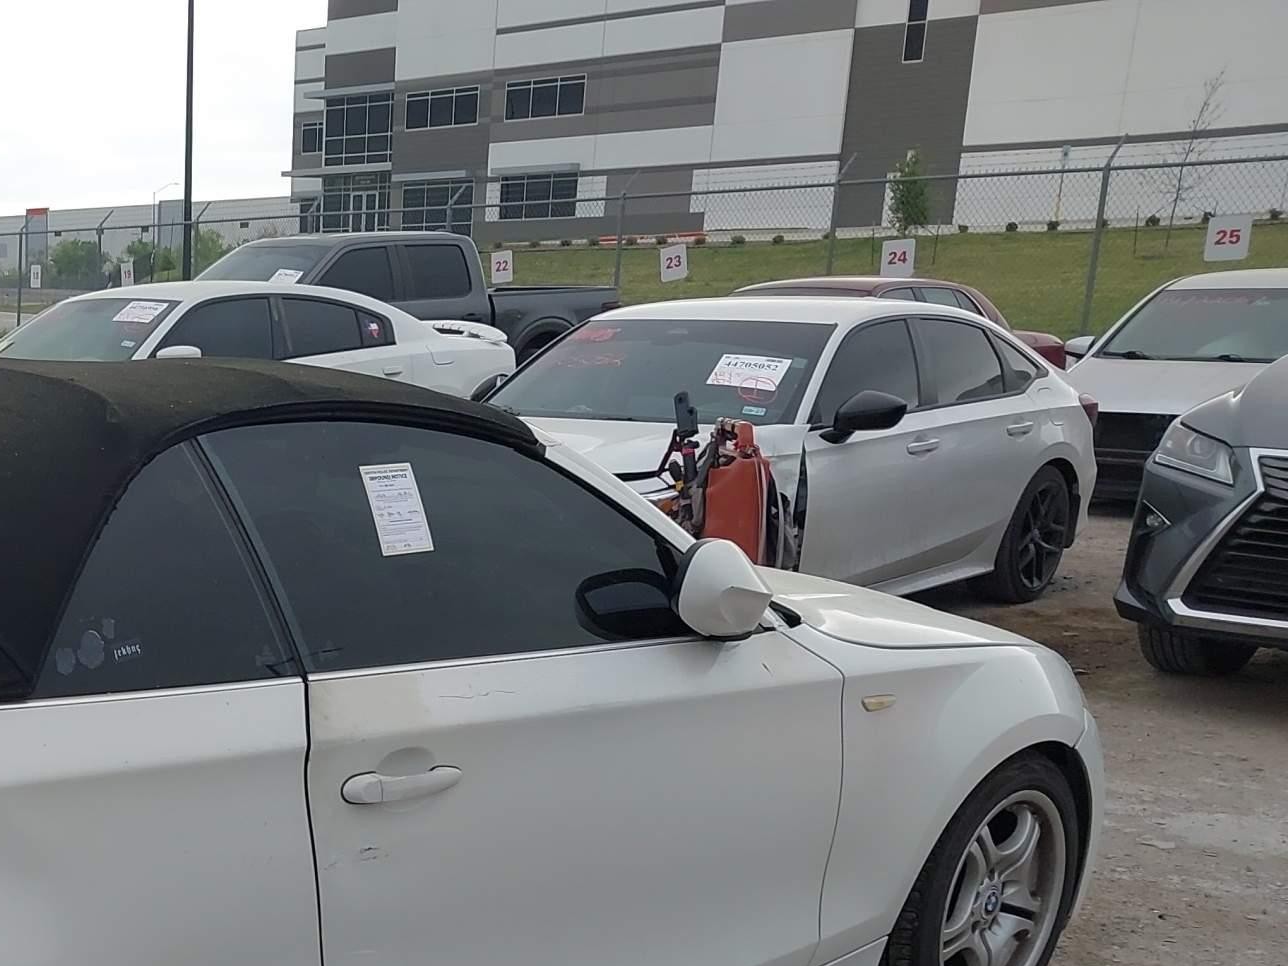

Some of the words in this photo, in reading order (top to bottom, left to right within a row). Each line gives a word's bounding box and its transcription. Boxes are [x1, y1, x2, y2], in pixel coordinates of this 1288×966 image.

[1214, 229, 1241, 245] 25
[665, 255, 682, 270] 23
[887, 250, 908, 265] 24
[495, 260, 509, 272] 22
